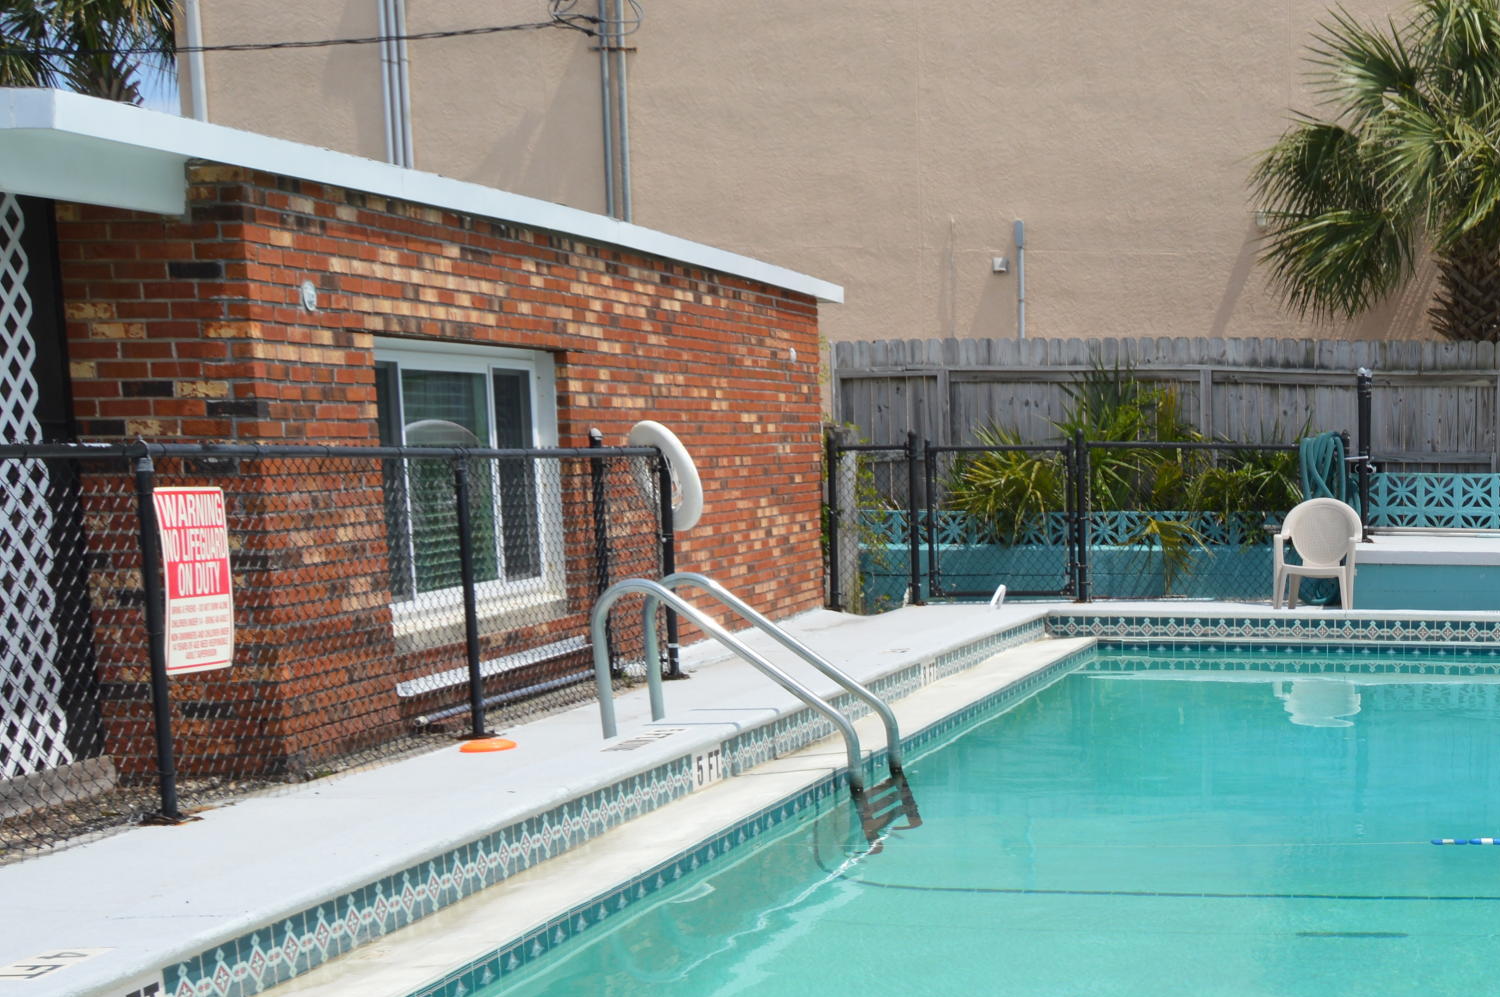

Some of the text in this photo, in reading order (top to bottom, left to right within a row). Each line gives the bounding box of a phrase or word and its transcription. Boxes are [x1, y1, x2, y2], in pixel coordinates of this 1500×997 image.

[157, 493, 224, 528] WARNING
[162, 527, 227, 562] NO LIFEGUARD
[178, 561, 220, 596] ON DUTY
[697, 756, 704, 786] 5
